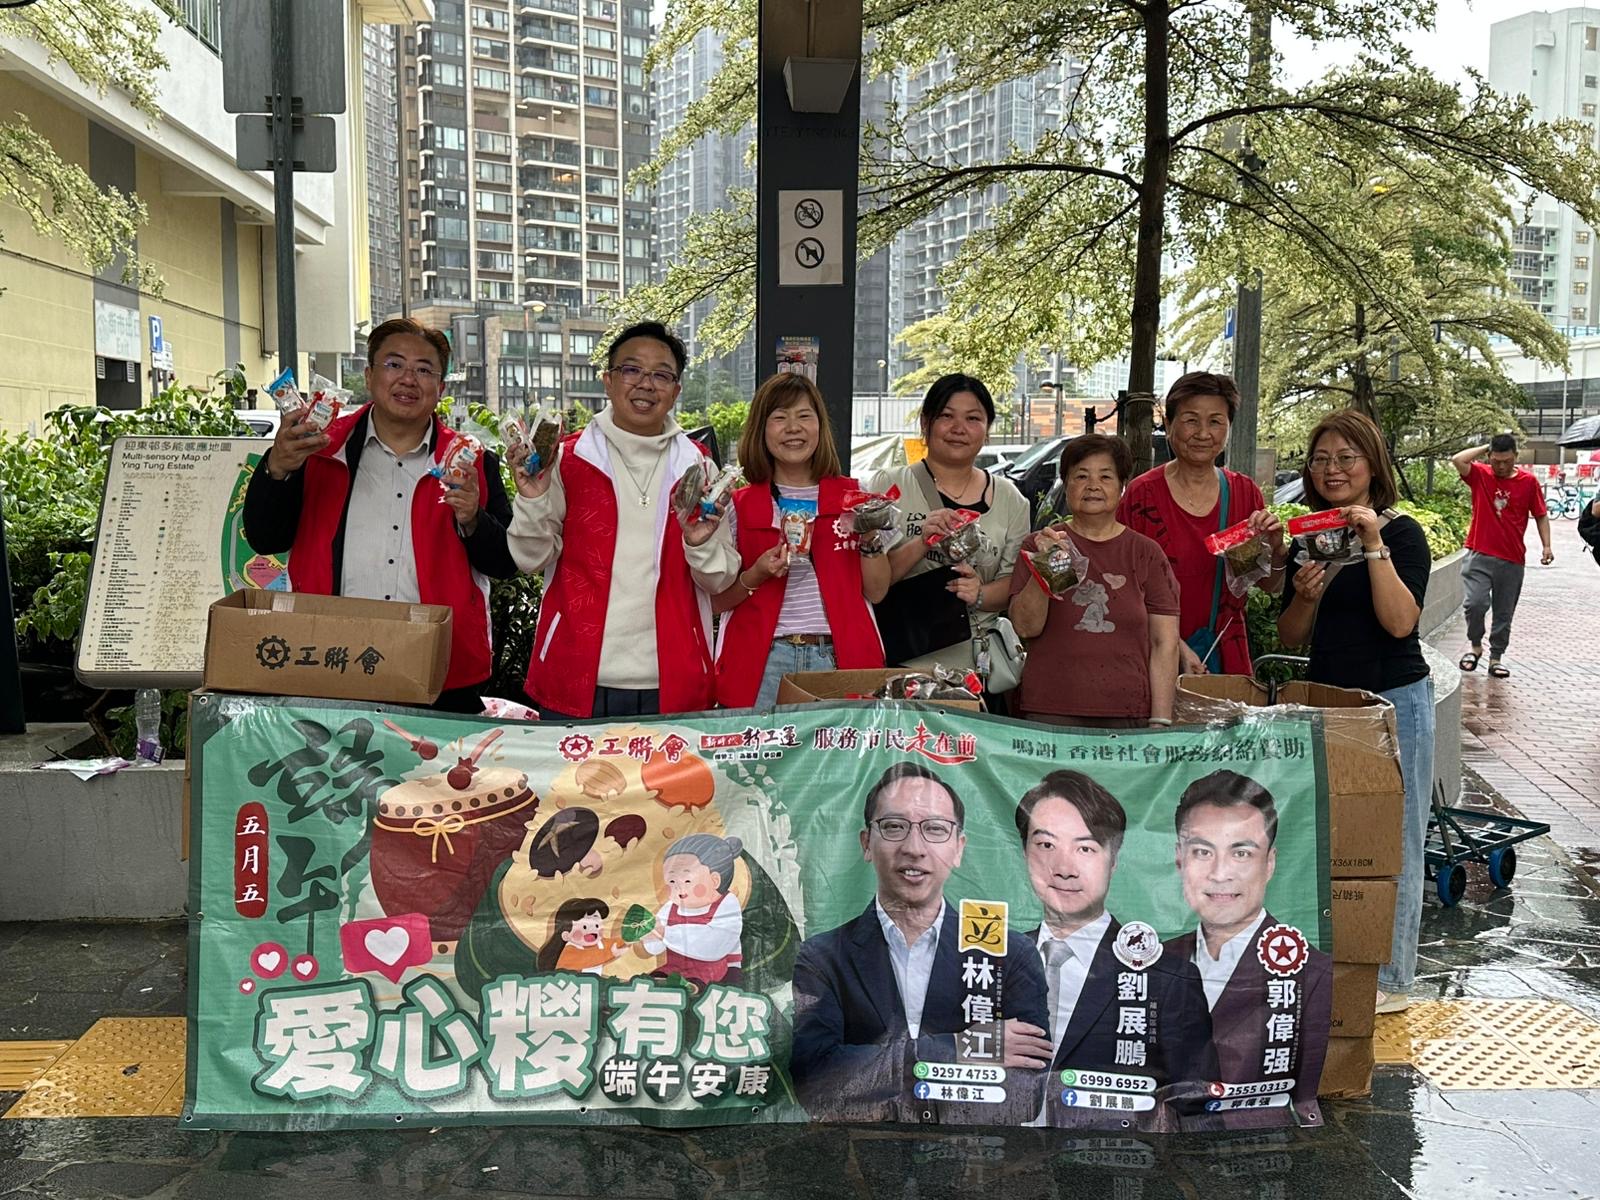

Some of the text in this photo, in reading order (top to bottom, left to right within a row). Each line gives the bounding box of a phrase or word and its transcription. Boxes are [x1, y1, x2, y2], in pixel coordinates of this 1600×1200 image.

[152, 320, 160, 349] P
[121, 461, 194, 471] Ying Tung Estate
[122, 452, 211, 462] Multi-sensory Map of
[295, 646, 385, 675] 工聯會
[599, 733, 688, 762] 工聯會
[814, 720, 977, 764] 服務市民走在前
[235, 815, 266, 904] 五月五
[961, 956, 994, 1059] 林偉江
[1114, 971, 1148, 1067] 劉展鵬
[604, 1061, 770, 1098] 端午安康
[932, 1066, 998, 1081] 9297 4753
[1080, 1073, 1148, 1090] 6999 6952
[941, 1086, 985, 1101] 林偉江
[1089, 1093, 1134, 1109] 劉展鵬
[1228, 1081, 1288, 1096] 2555 0313
